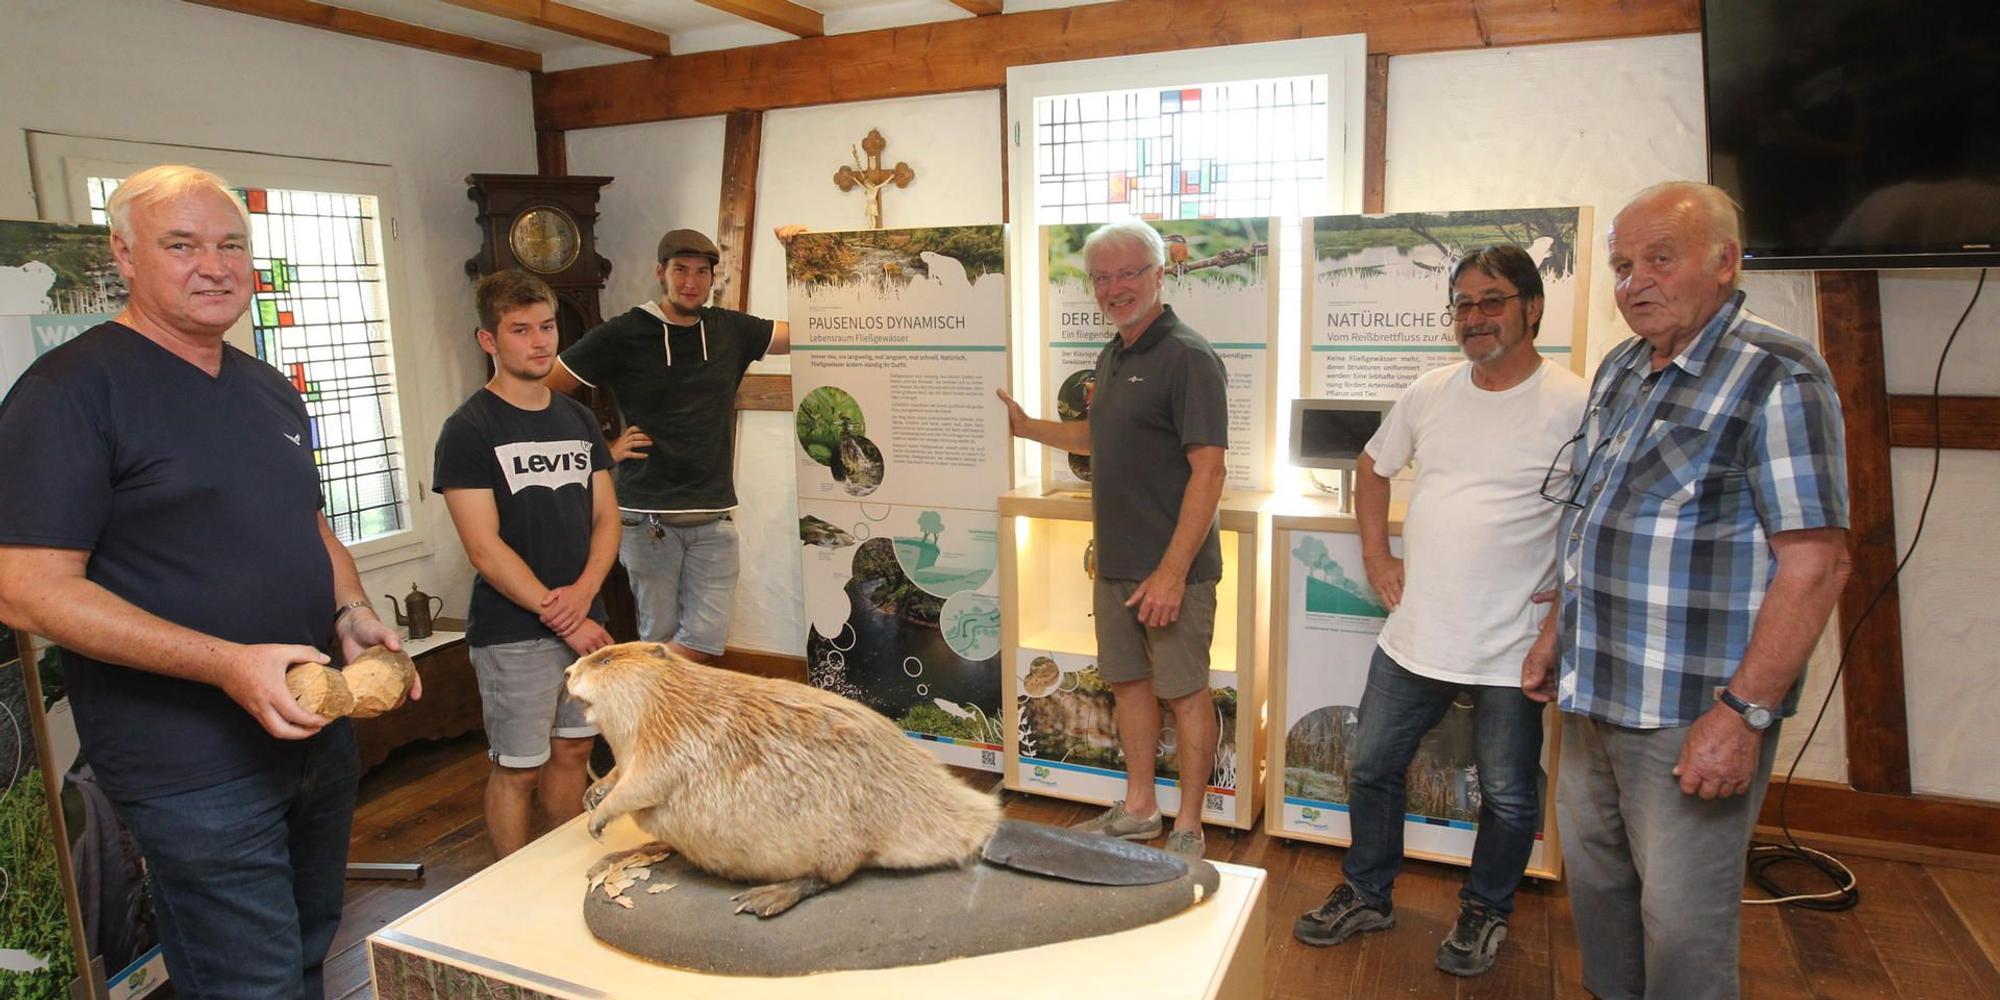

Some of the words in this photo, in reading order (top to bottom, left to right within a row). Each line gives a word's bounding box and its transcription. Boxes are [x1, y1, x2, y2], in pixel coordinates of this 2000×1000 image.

[809, 316, 884, 330] PAUSENLOS
[887, 315, 966, 330] DYNAMISCH
[1061, 312, 1090, 326] DER
[1327, 310, 1436, 328] NATÜRLICHE
[1440, 312, 1454, 328] O
[36, 325, 91, 348] WA
[809, 333, 854, 342] Lebensraum
[855, 333, 909, 344] Fließgewässer
[1061, 330, 1075, 339] Ein
[1076, 330, 1117, 341] fliegende
[1327, 332, 1349, 342] Vom
[1351, 332, 1421, 343] Reißbrettfluss
[1422, 334, 1439, 342] zur
